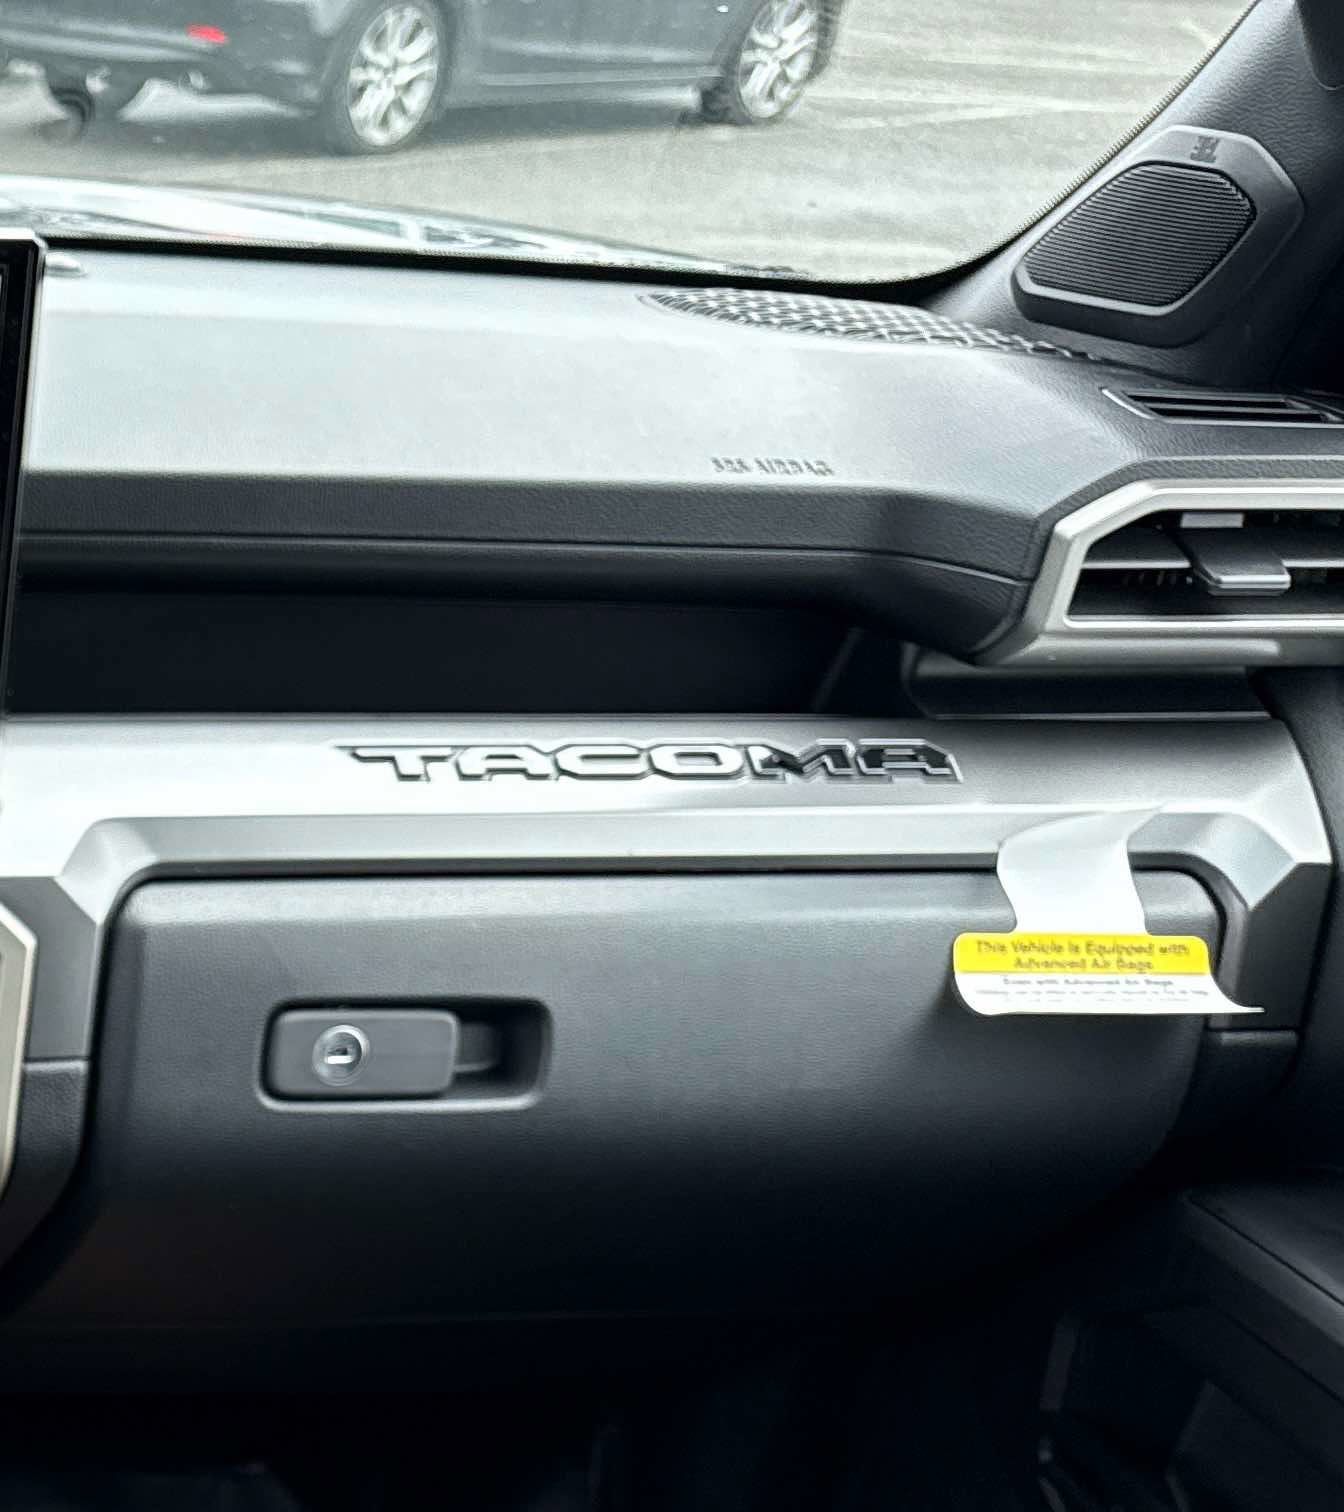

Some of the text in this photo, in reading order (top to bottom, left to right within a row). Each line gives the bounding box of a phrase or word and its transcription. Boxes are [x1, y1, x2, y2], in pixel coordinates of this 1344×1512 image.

[331, 738, 964, 784] TACOMA
[976, 940, 1007, 953] This
[1012, 940, 1063, 954] Vehicle
[1085, 941, 1154, 957] Equipped
[1014, 957, 1087, 970] Advanced
[1117, 958, 1153, 974] Bags
